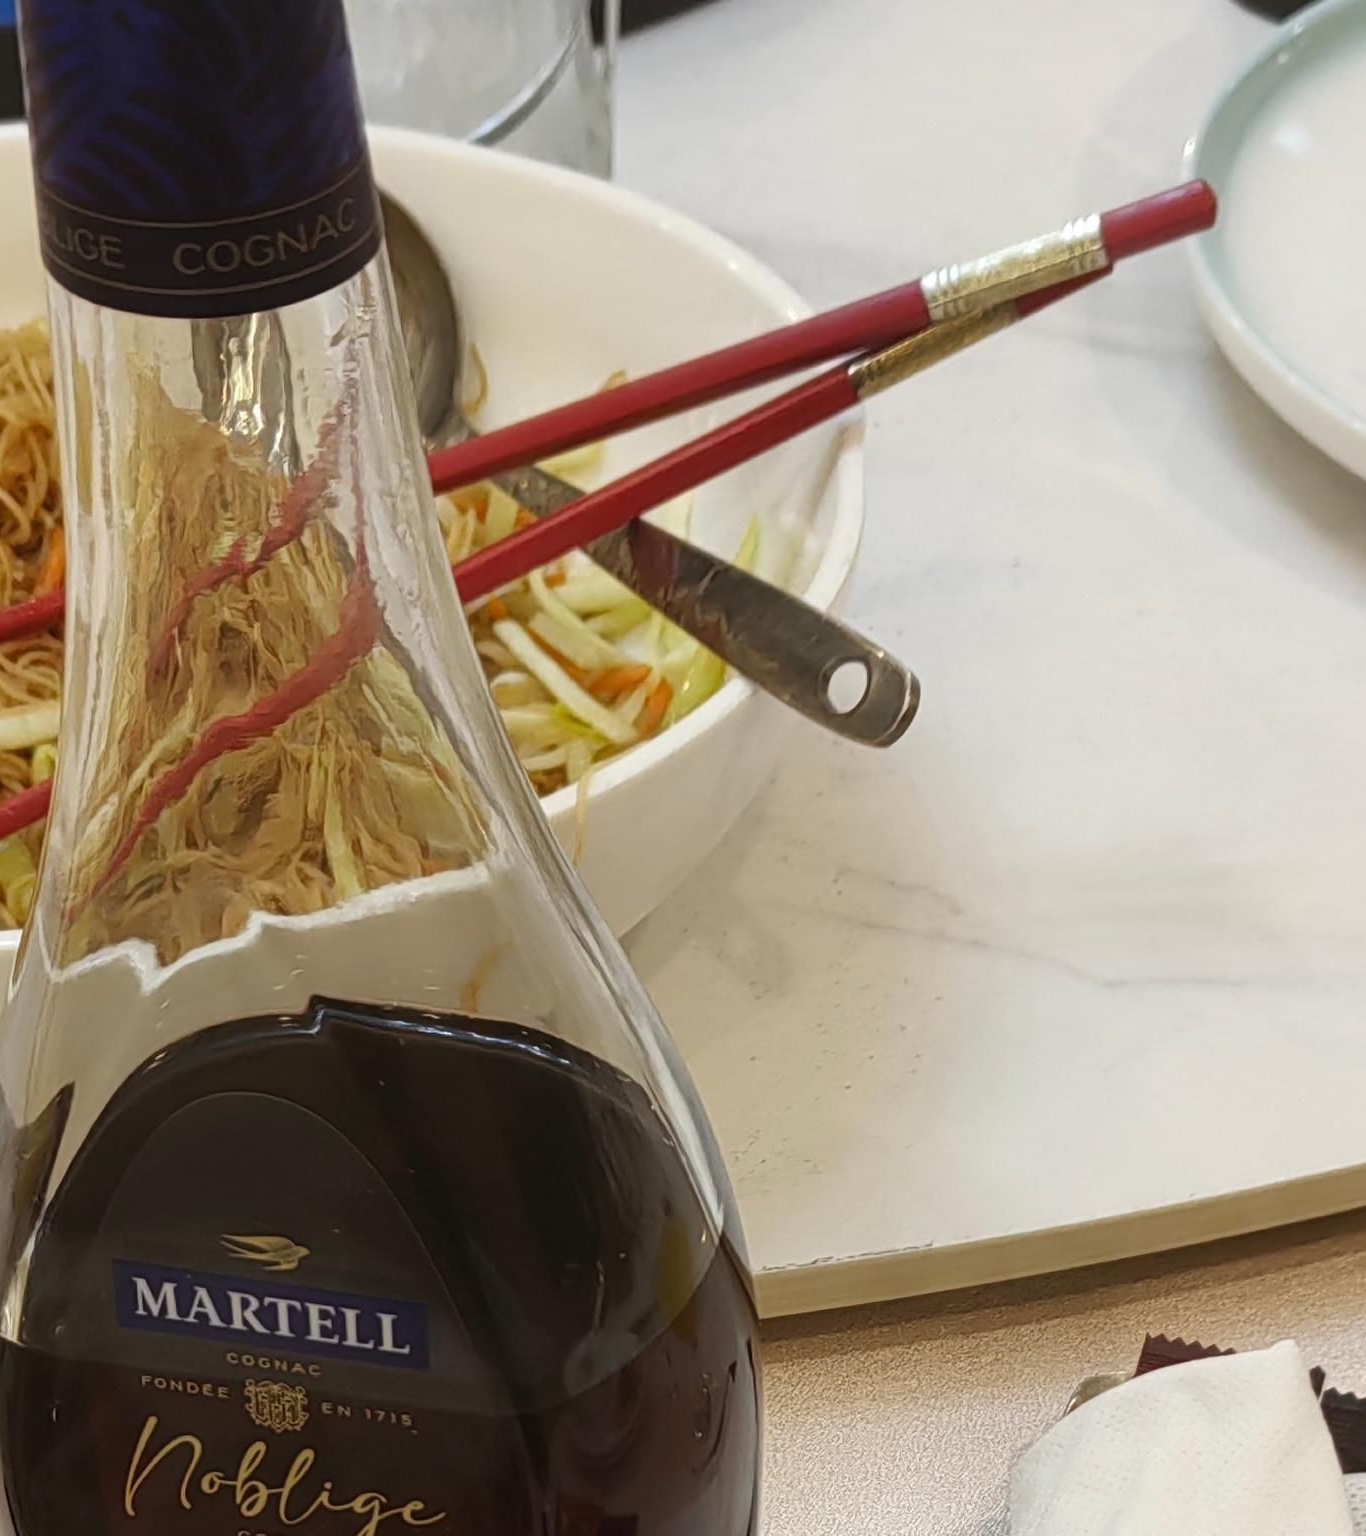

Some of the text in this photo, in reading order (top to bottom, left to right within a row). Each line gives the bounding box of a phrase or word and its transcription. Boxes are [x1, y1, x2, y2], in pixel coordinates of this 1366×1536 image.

[43, 198, 356, 276] LIGE COGNAC
[132, 1276, 411, 1355] MARTELL
[226, 1352, 323, 1377] COGNAC
[321, 1402, 353, 1418] EN
[364, 1408, 413, 1427] 1715
